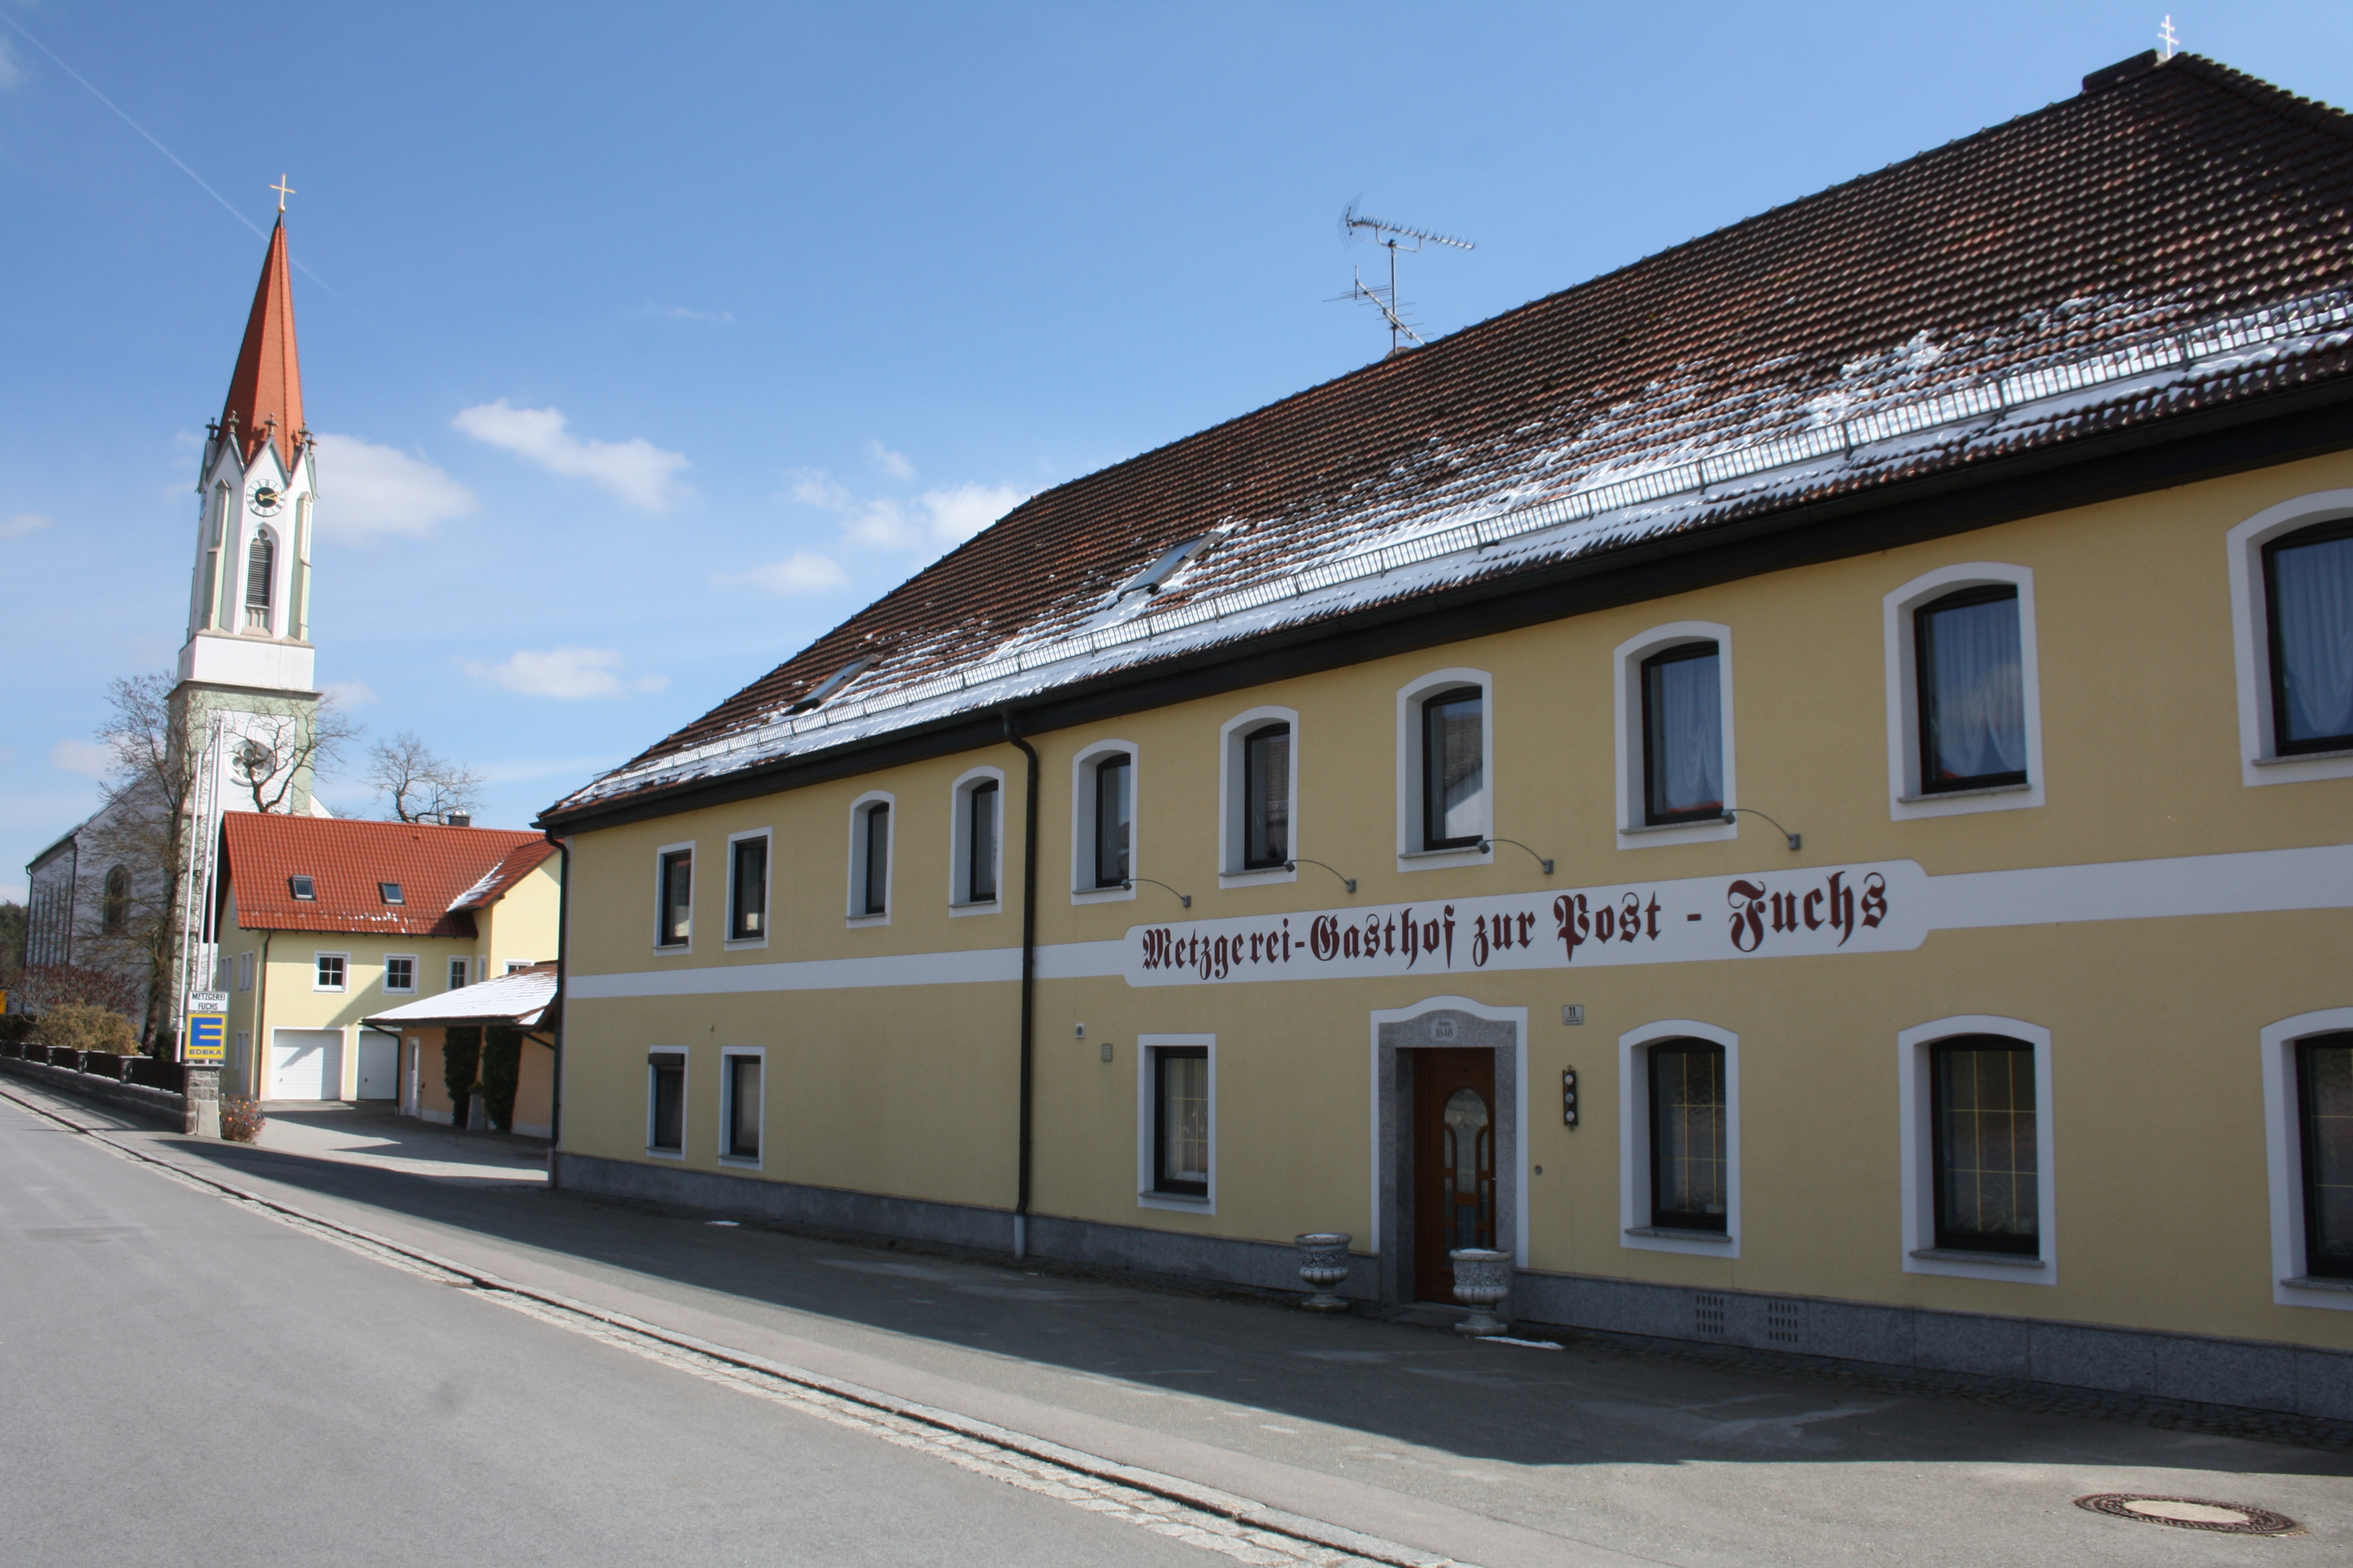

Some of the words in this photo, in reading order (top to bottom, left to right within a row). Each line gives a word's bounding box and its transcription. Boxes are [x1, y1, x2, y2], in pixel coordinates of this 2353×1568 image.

[1142, 904, 1457, 980] Metzgerei-Gasthof
[1472, 911, 1536, 967] zur
[1553, 891, 1661, 962] Post
[1727, 870, 1889, 953] Fuchs
[191, 992, 226, 1001] METZGEREI
[1569, 1006, 1576, 1017] 11
